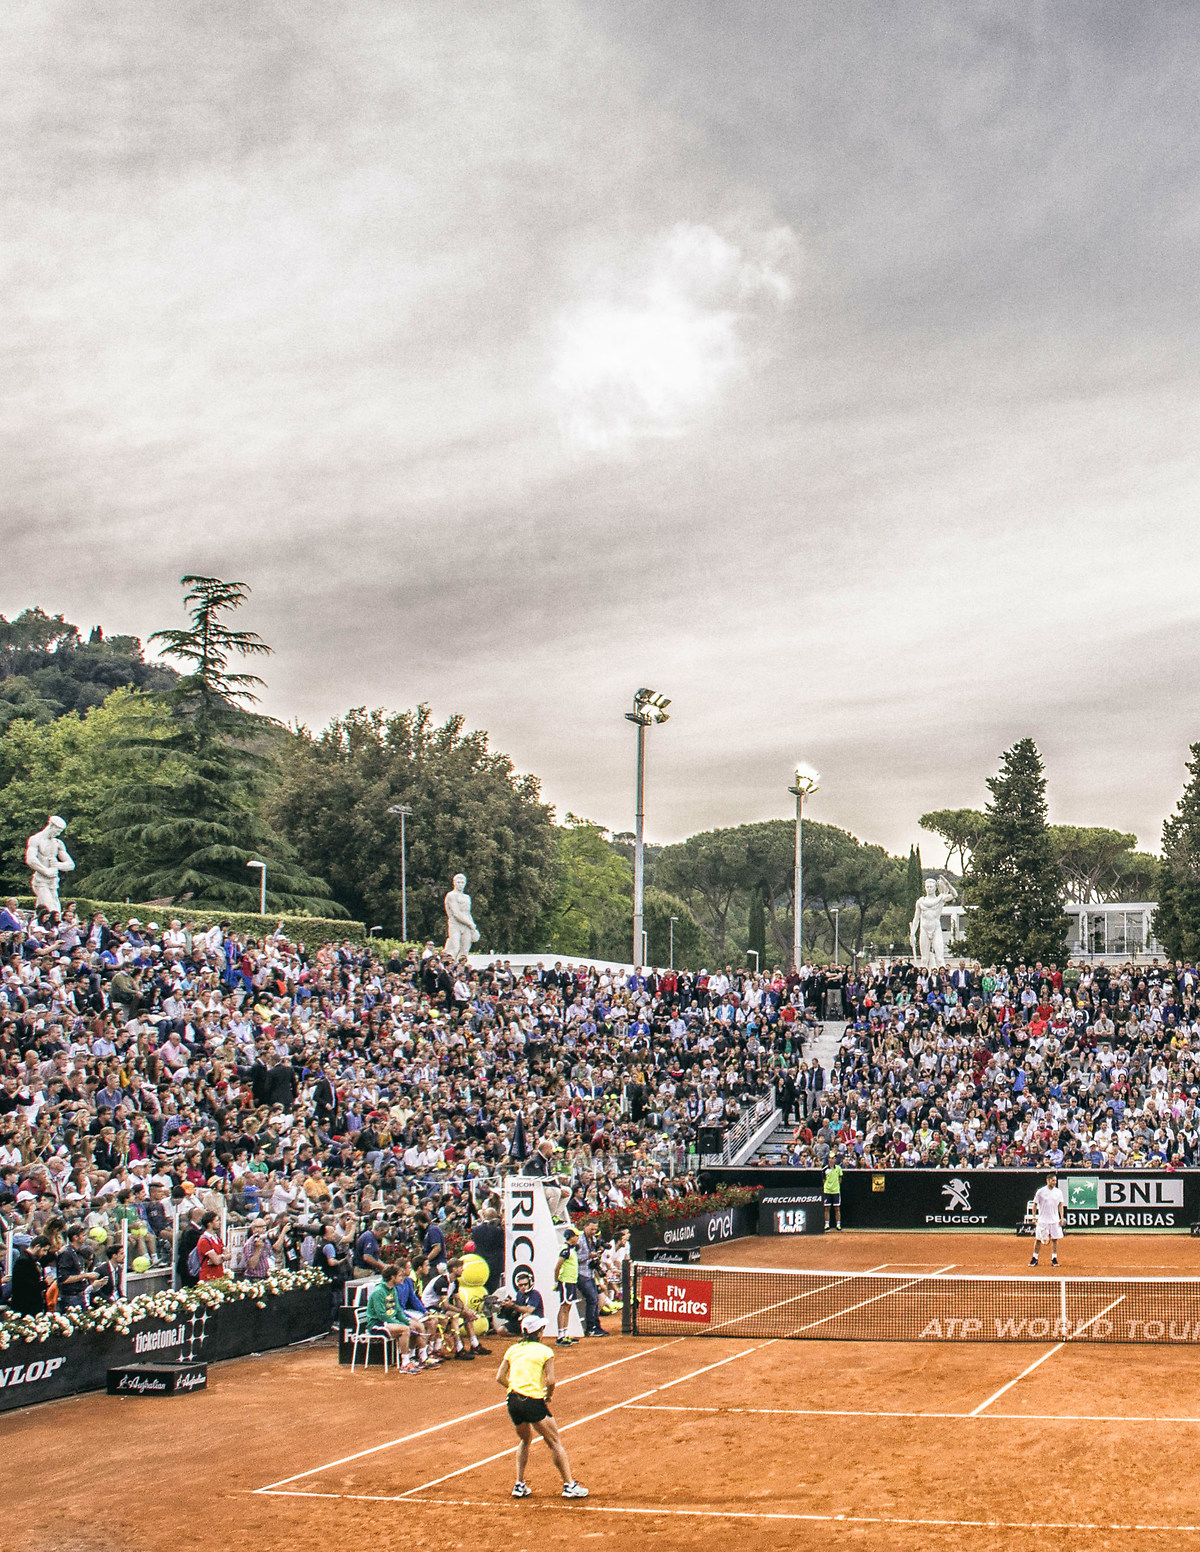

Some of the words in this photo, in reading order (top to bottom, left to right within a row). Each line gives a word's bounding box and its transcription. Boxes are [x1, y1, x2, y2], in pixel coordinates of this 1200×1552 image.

[762, 1195, 822, 1204] FRECCIAROSSA
[1105, 1182, 1174, 1204] BNL
[708, 1208, 734, 1241] enel
[777, 1210, 806, 1226] 118
[925, 1215, 988, 1224] PEUGEOT
[1066, 1213, 1100, 1226] BNP
[1105, 1213, 1175, 1226] PARIBAS
[512, 1191, 535, 1293] RICO
[672, 1226, 695, 1242] ALGIDA
[667, 1285, 686, 1299] Fly
[644, 1295, 708, 1315] Emirates
[918, 1318, 983, 1338] ATP
[993, 1318, 1114, 1339] WORLD
[135, 1325, 186, 1353] ticketone.it
[0, 1357, 63, 1388] NLOP
